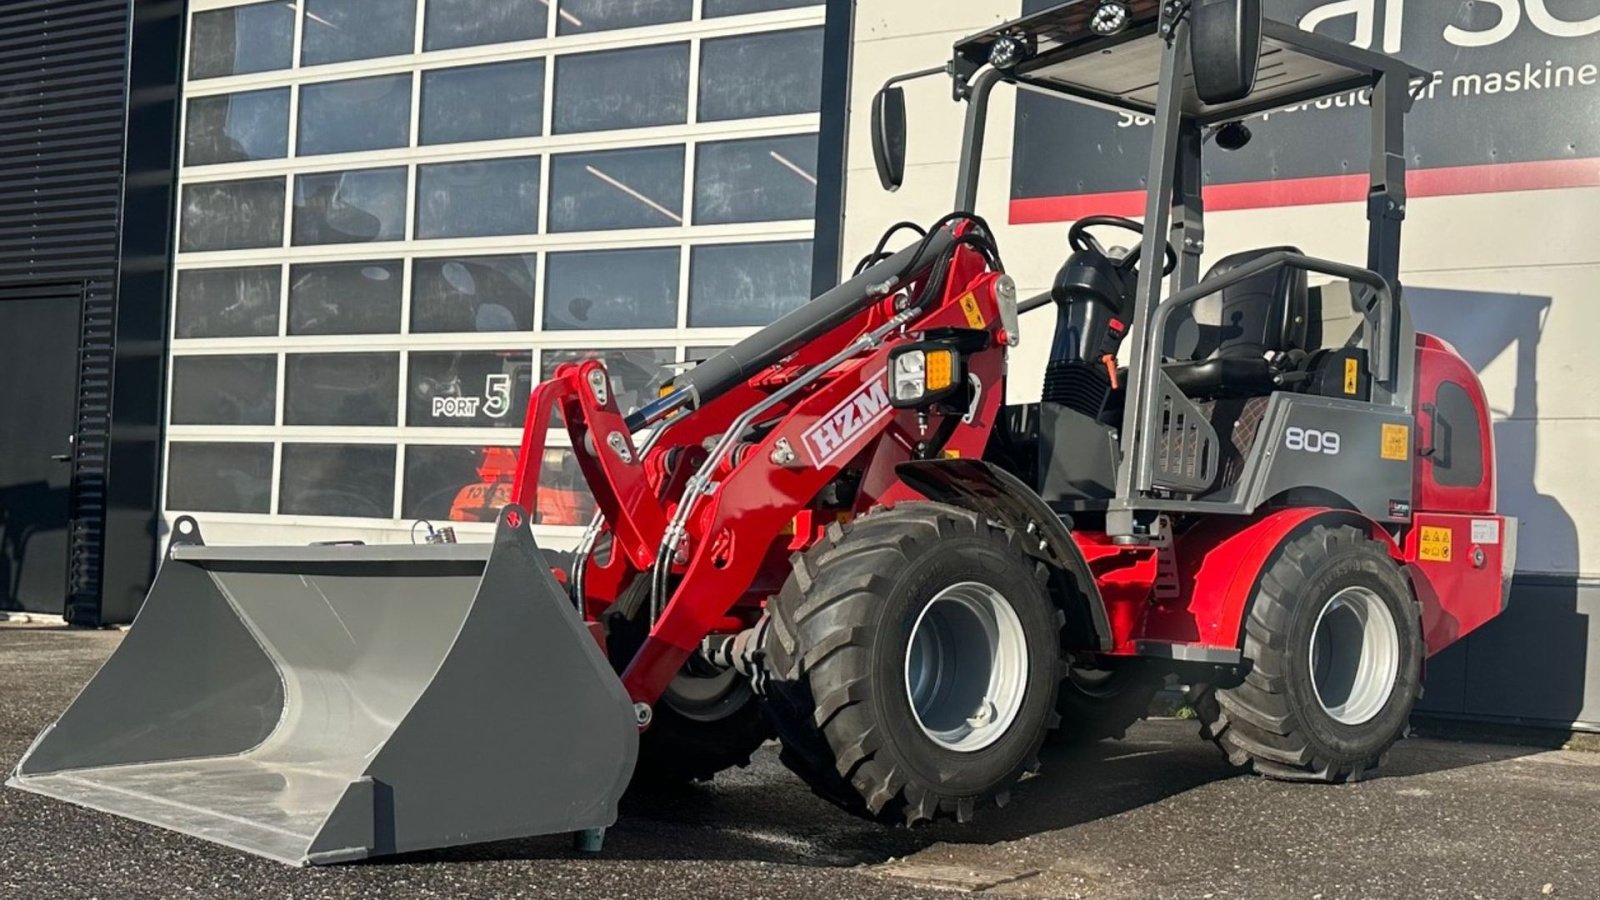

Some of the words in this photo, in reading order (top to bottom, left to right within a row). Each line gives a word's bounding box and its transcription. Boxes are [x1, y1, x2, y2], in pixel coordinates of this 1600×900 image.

[1451, 60, 1597, 97] maskine
[432, 397, 480, 417] PORT
[482, 374, 511, 418] 5
[811, 379, 890, 459] HZM
[1285, 426, 1340, 455] 809
